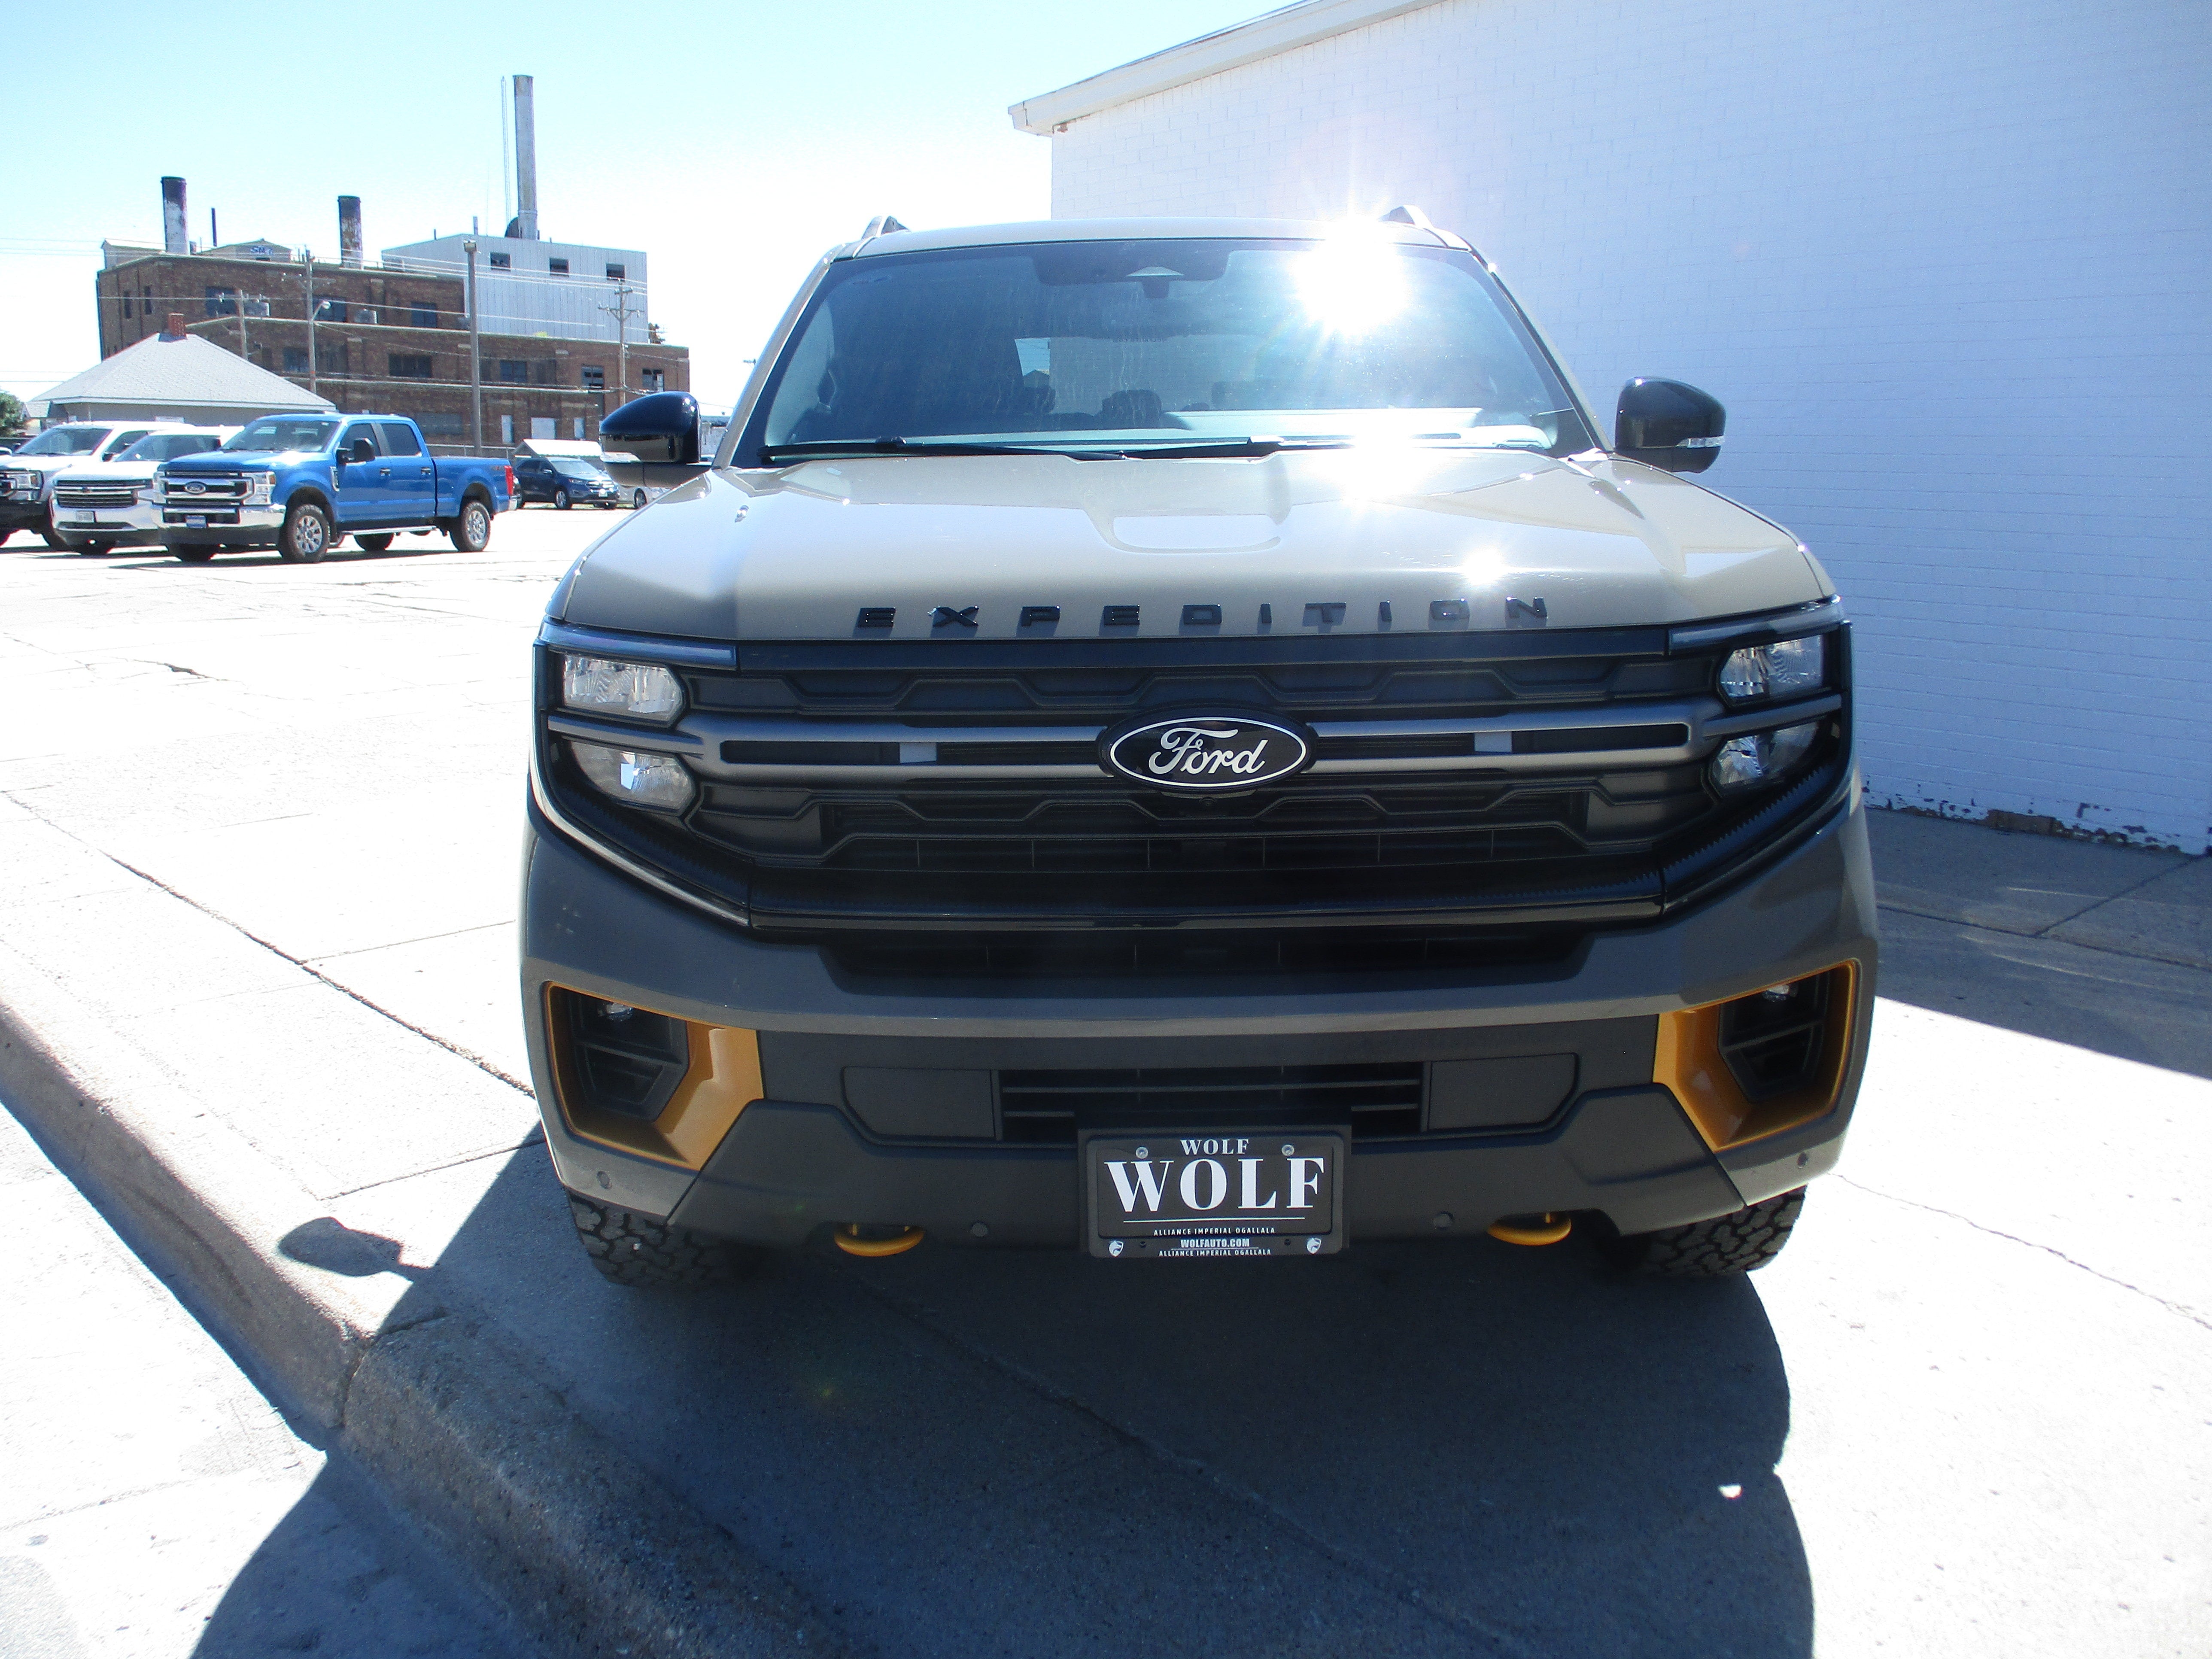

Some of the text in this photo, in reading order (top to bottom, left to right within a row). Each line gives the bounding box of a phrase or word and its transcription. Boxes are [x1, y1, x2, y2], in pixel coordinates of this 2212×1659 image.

[860, 597, 1548, 627] EXPEDITION
[1148, 727, 1269, 774] Ford
[1180, 1139, 1249, 1155] WOLF
[1103, 1158, 1324, 1212] WOLF
[1153, 1228, 1191, 1236] ALLIANCE
[1180, 1238, 1250, 1248] WOLFAUTO.COM
